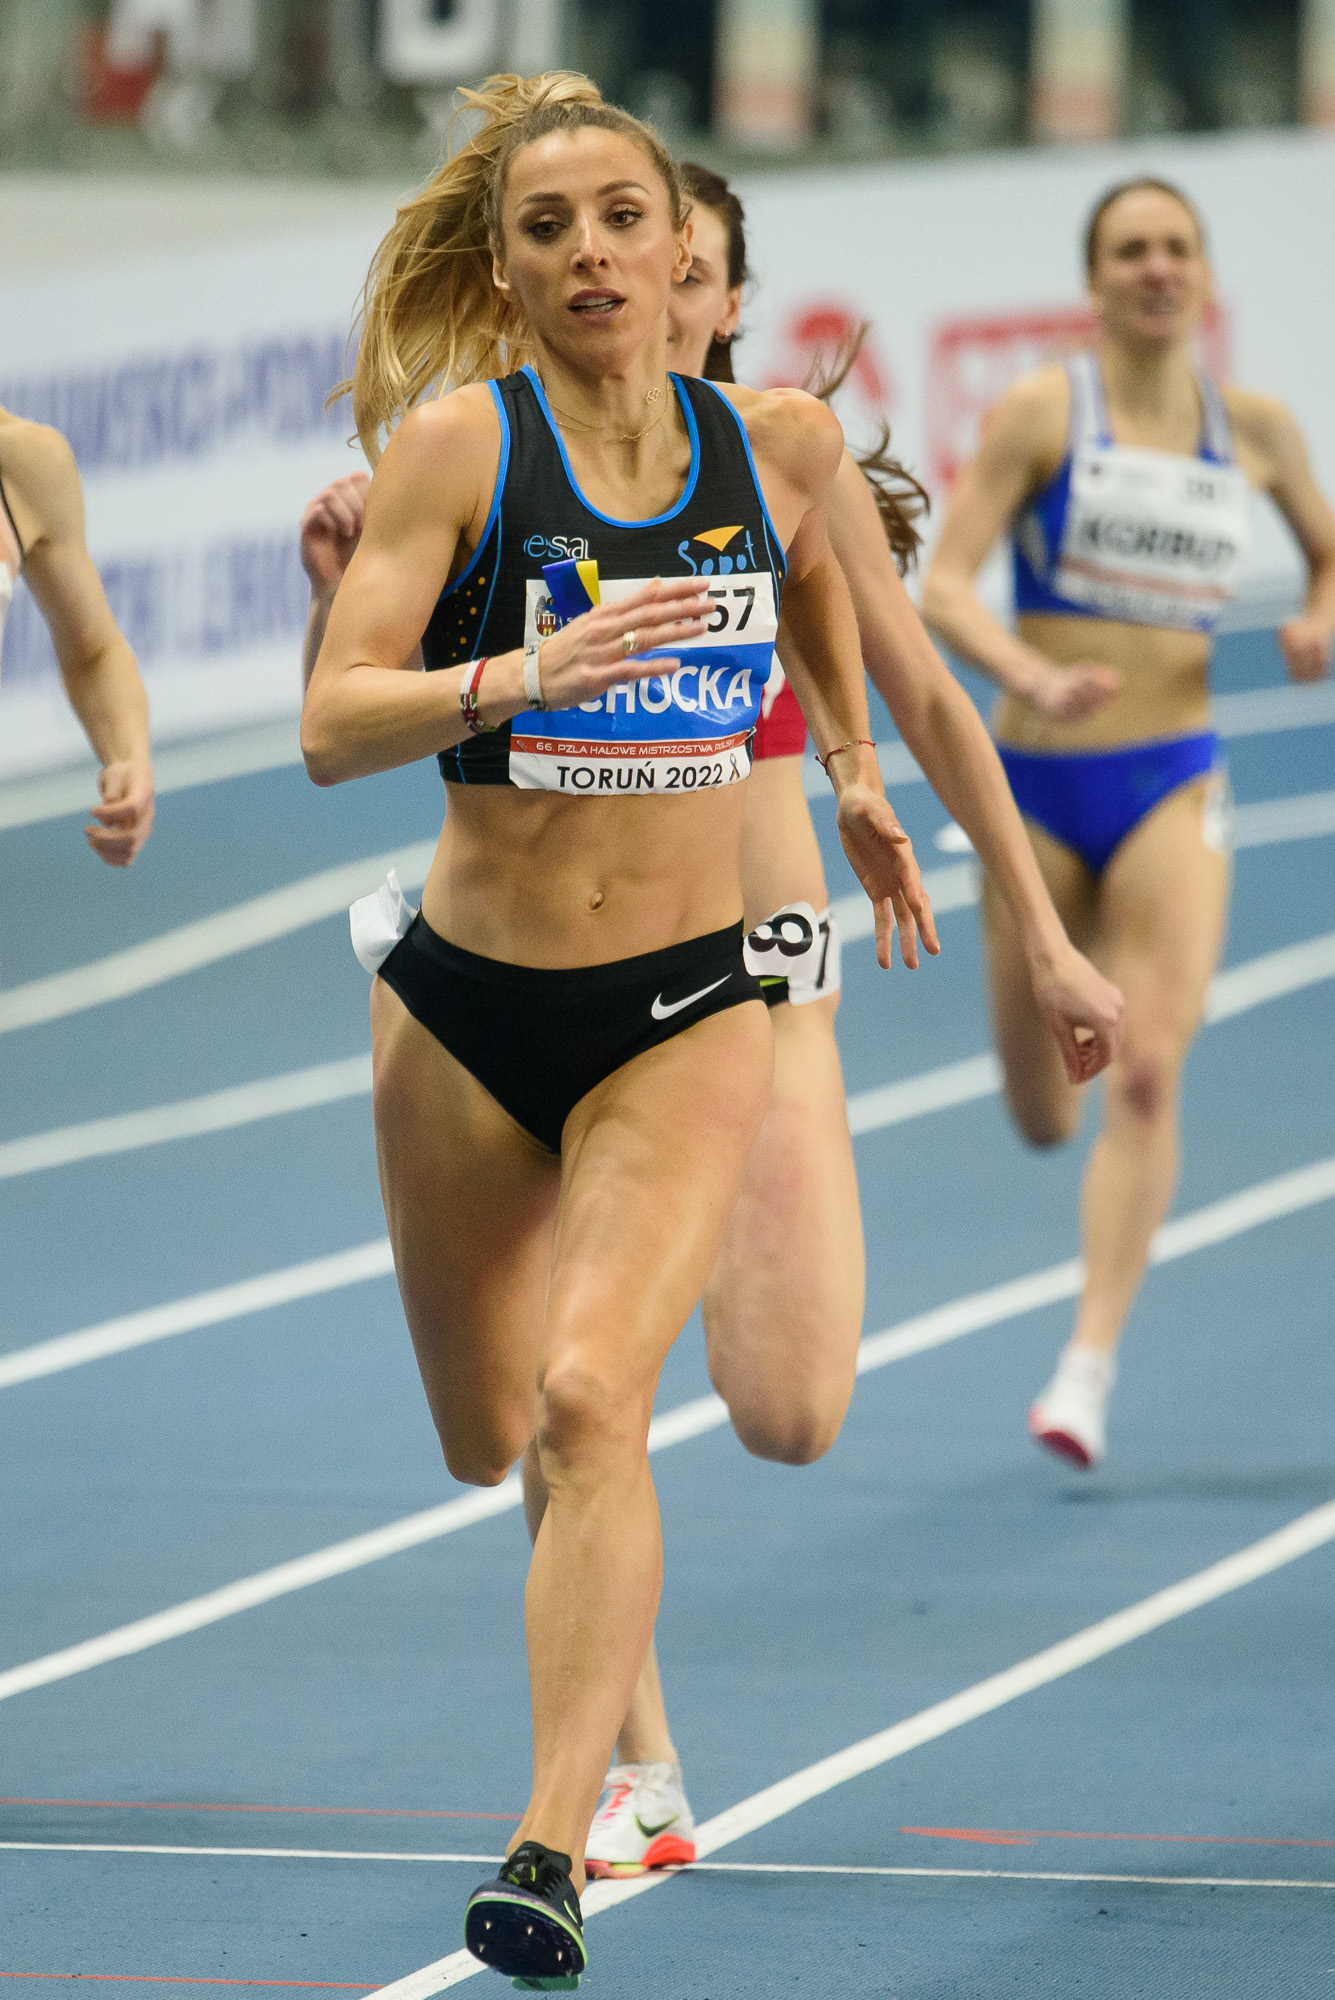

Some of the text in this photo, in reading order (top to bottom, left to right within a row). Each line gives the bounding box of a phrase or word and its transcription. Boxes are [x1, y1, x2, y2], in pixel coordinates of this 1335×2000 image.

[523, 534, 590, 560] esa
[677, 529, 757, 577] Sopot
[677, 586, 756, 633] 57
[562, 664, 753, 715] HOCKA
[557, 744, 588, 755] PZLA
[589, 745, 636, 757] HALOWE
[638, 743, 714, 756] MISTRZOSTWA
[556, 761, 723, 790] TORUŃ 2022
